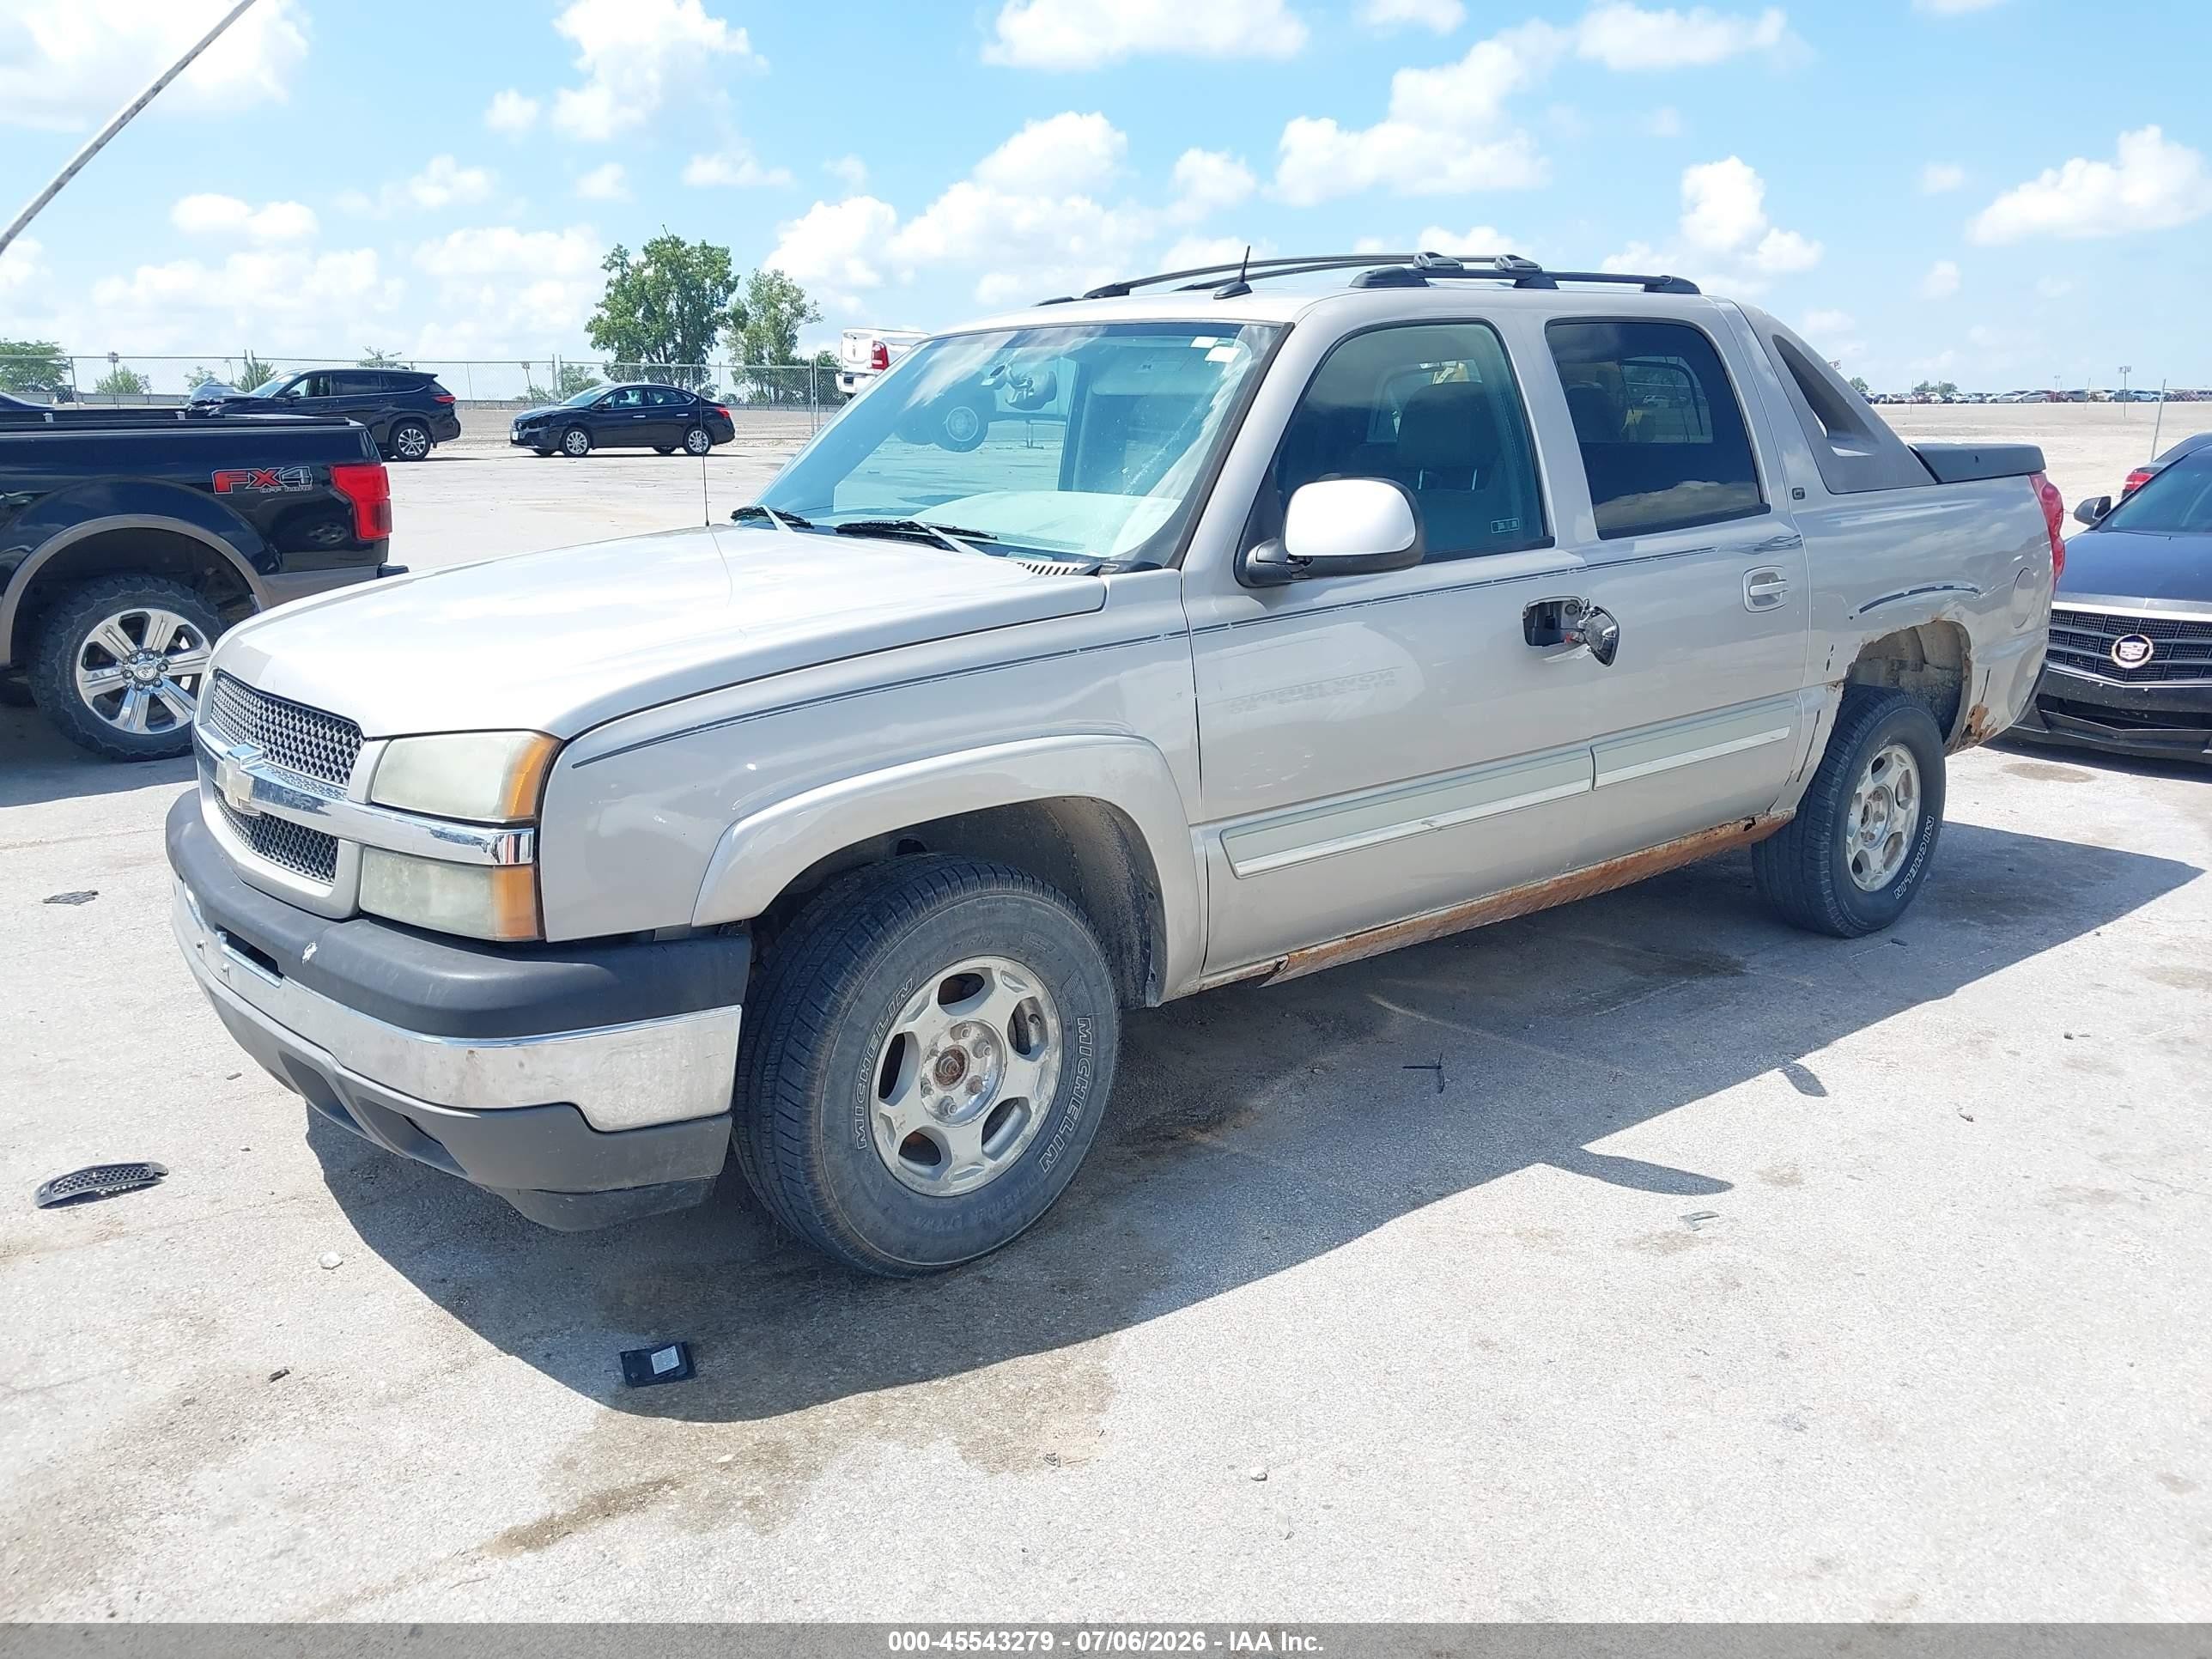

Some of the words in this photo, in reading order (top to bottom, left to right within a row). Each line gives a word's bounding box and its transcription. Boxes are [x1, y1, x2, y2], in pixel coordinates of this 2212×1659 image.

[211, 466, 313, 495] FX4
[1893, 815, 1935, 900] MICHELIN
[854, 977, 915, 1151] MICHELIN
[1038, 1016, 1093, 1175] MICHELIN
